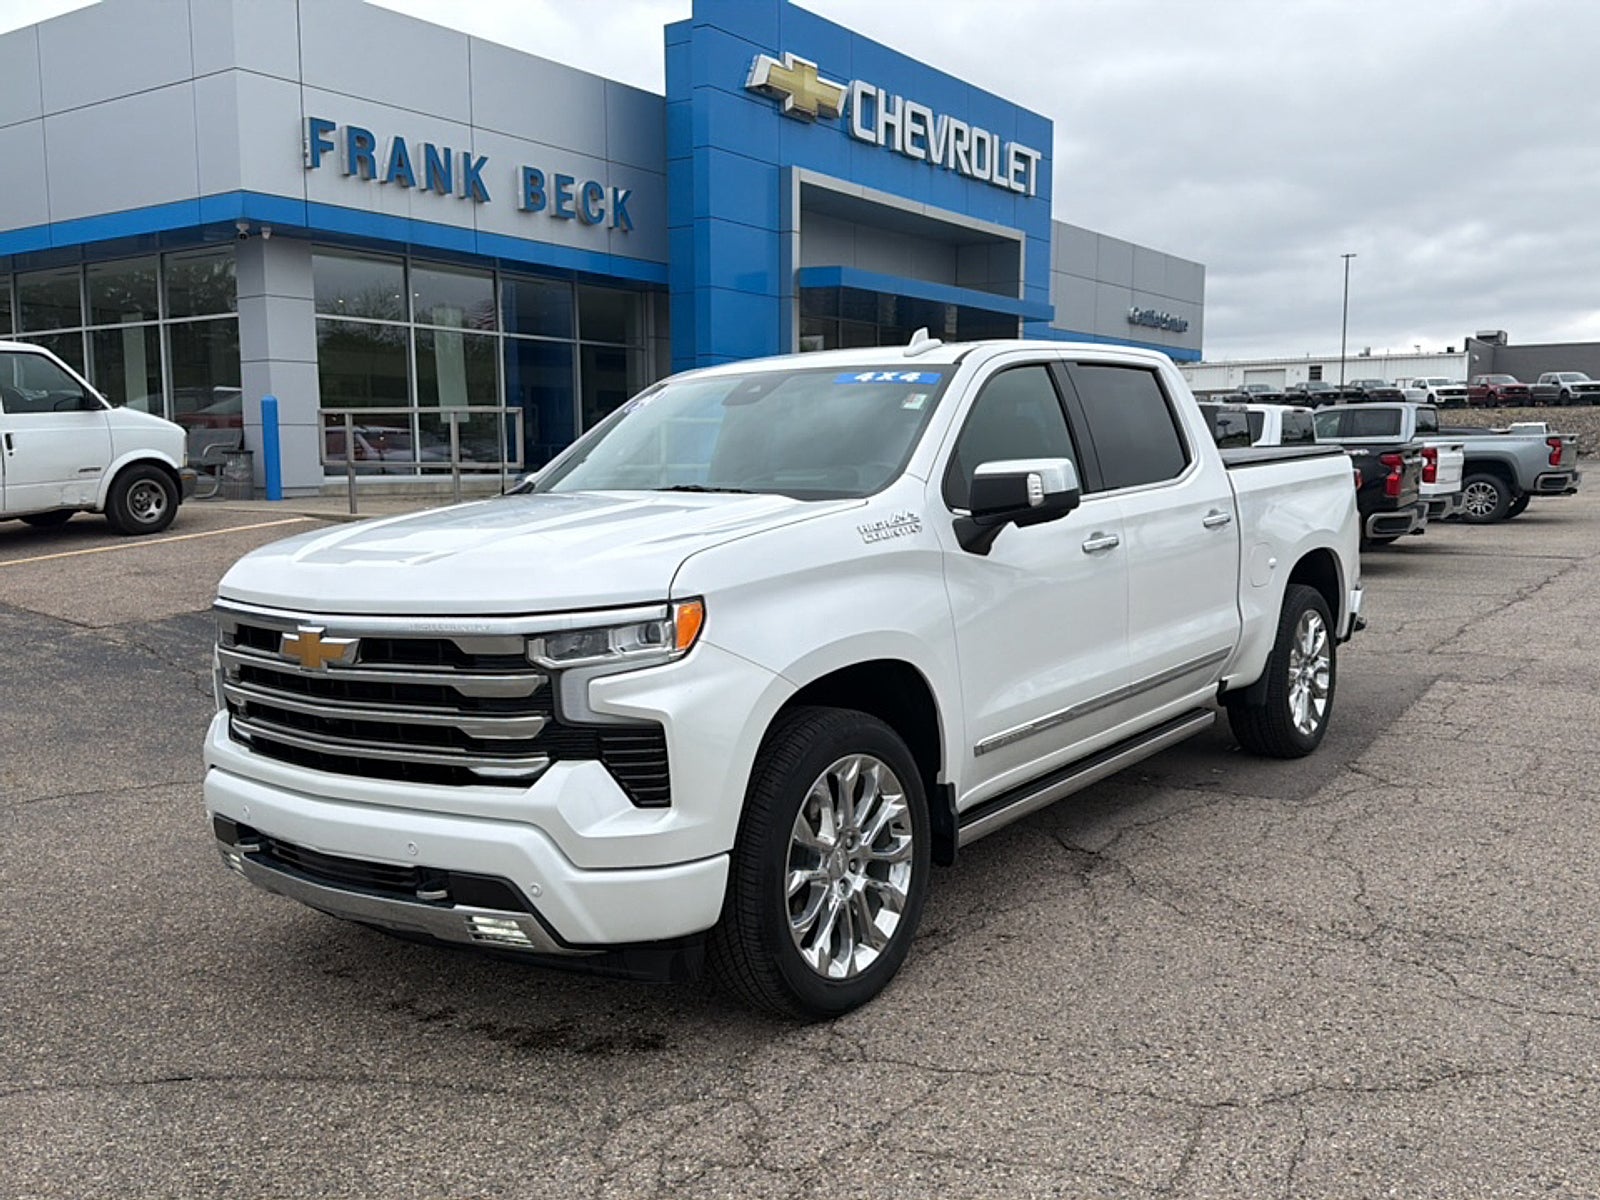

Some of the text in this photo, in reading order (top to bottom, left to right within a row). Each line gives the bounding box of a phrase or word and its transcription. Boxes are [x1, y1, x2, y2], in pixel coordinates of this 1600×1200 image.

[304, 116, 634, 232] FRANK BECK
[850, 80, 1041, 197] CHEVROLET
